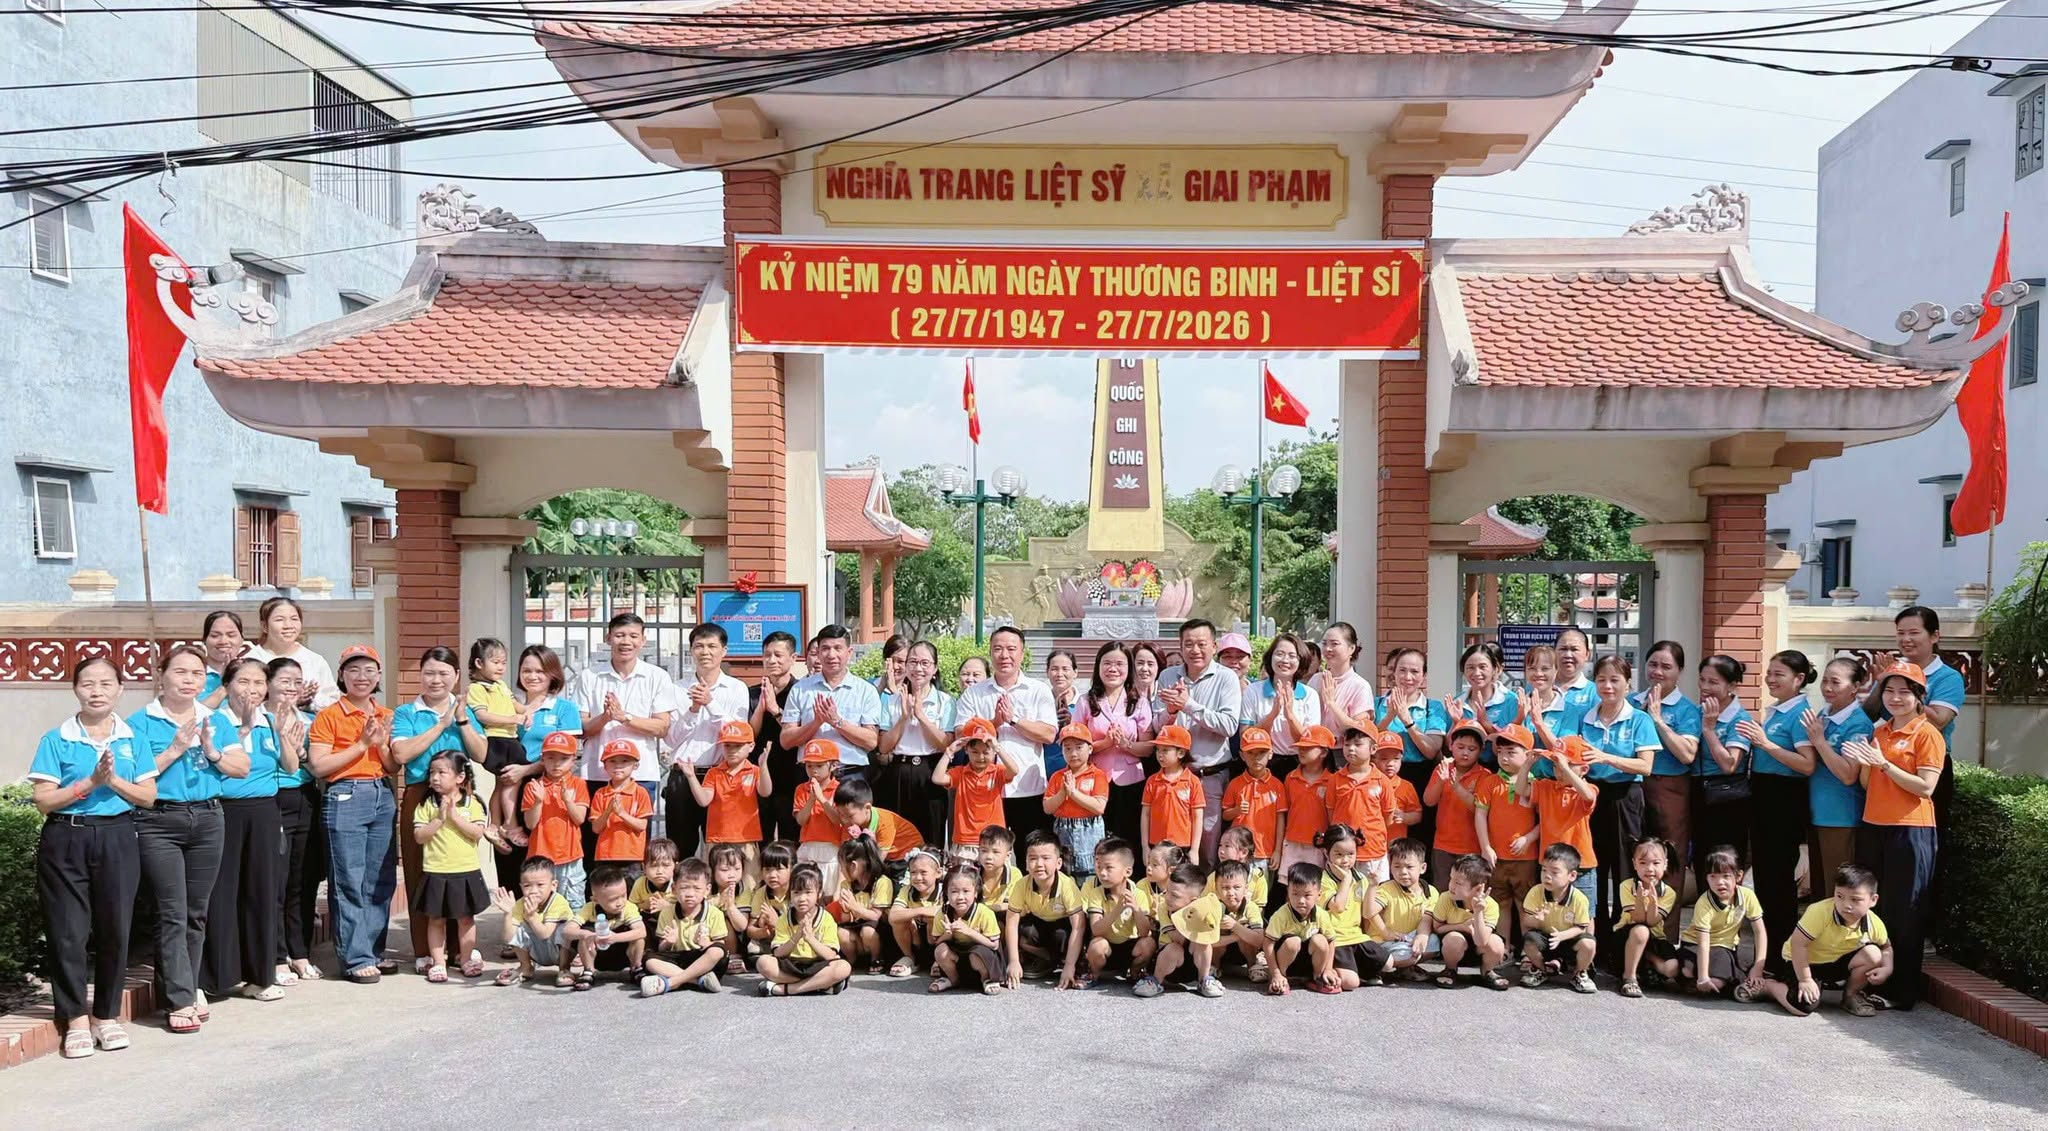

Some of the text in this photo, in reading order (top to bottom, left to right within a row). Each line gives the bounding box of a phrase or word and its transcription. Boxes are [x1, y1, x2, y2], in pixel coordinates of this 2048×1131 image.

[826, 160, 912, 200] NGHĨA
[919, 167, 1015, 202] TRANG
[1024, 161, 1083, 209] LIỆT
[1091, 163, 1126, 203] SỸ
[1184, 169, 1240, 203] GIAI
[1248, 169, 1333, 209] PHẠM
[759, 250, 796, 291] KỶ
[804, 255, 880, 299] NIỆM
[887, 263, 923, 294] 79
[931, 257, 998, 295] NĂM
[1006, 259, 1083, 296] NGÀY
[1089, 262, 1202, 297] THƯƠNG
[1209, 266, 1278, 297] BINH
[1305, 260, 1364, 304] LIỆT
[1371, 260, 1403, 297] SĨ
[911, 307, 1066, 339] 27/7/1947
[1096, 309, 1251, 340] 27/7/2026
[1110, 381, 1144, 401] QUỐC
[1116, 417, 1137, 433] GHI
[1109, 447, 1144, 466] CÔNG
